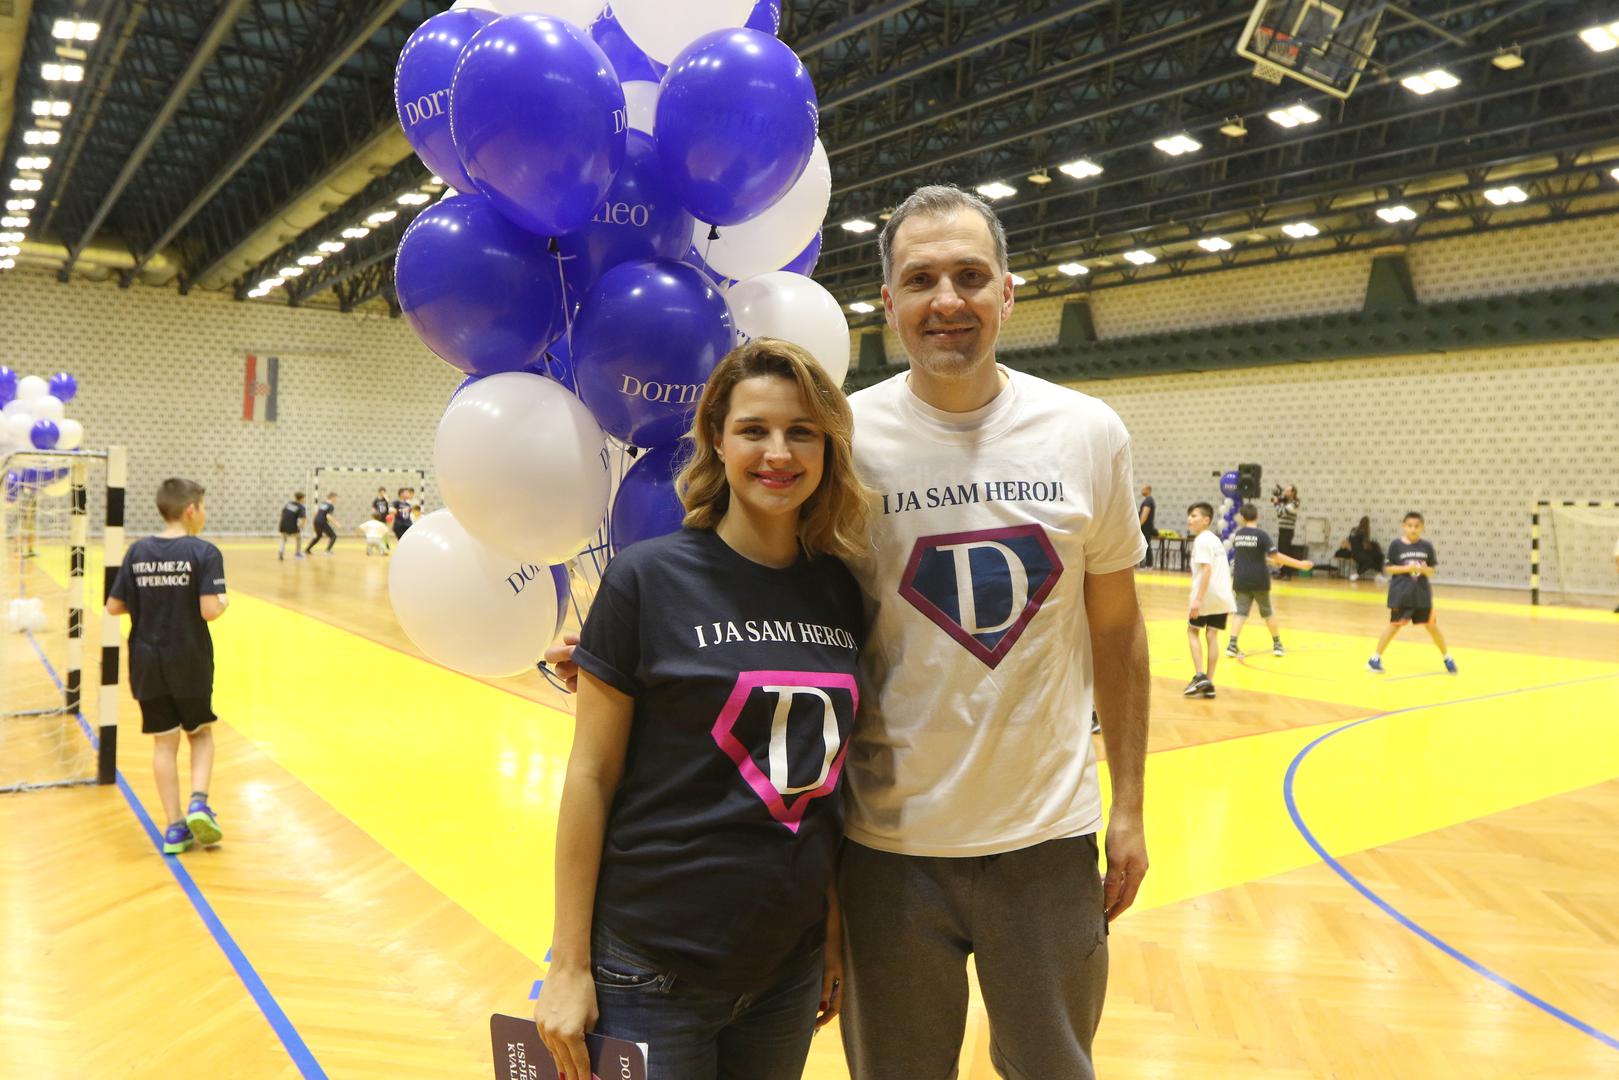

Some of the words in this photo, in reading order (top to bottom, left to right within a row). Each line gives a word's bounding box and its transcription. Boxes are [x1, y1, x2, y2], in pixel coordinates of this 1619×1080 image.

[404, 88, 450, 126] Dor
[882, 494, 890, 514] I
[895, 491, 922, 513] JA
[926, 483, 979, 508] SAM
[985, 481, 1065, 502] HEROJ!
[935, 540, 1029, 636] D
[694, 625, 708, 648] I
[712, 621, 743, 645] JA
[745, 620, 796, 642] SAM
[762, 685, 841, 795] D
